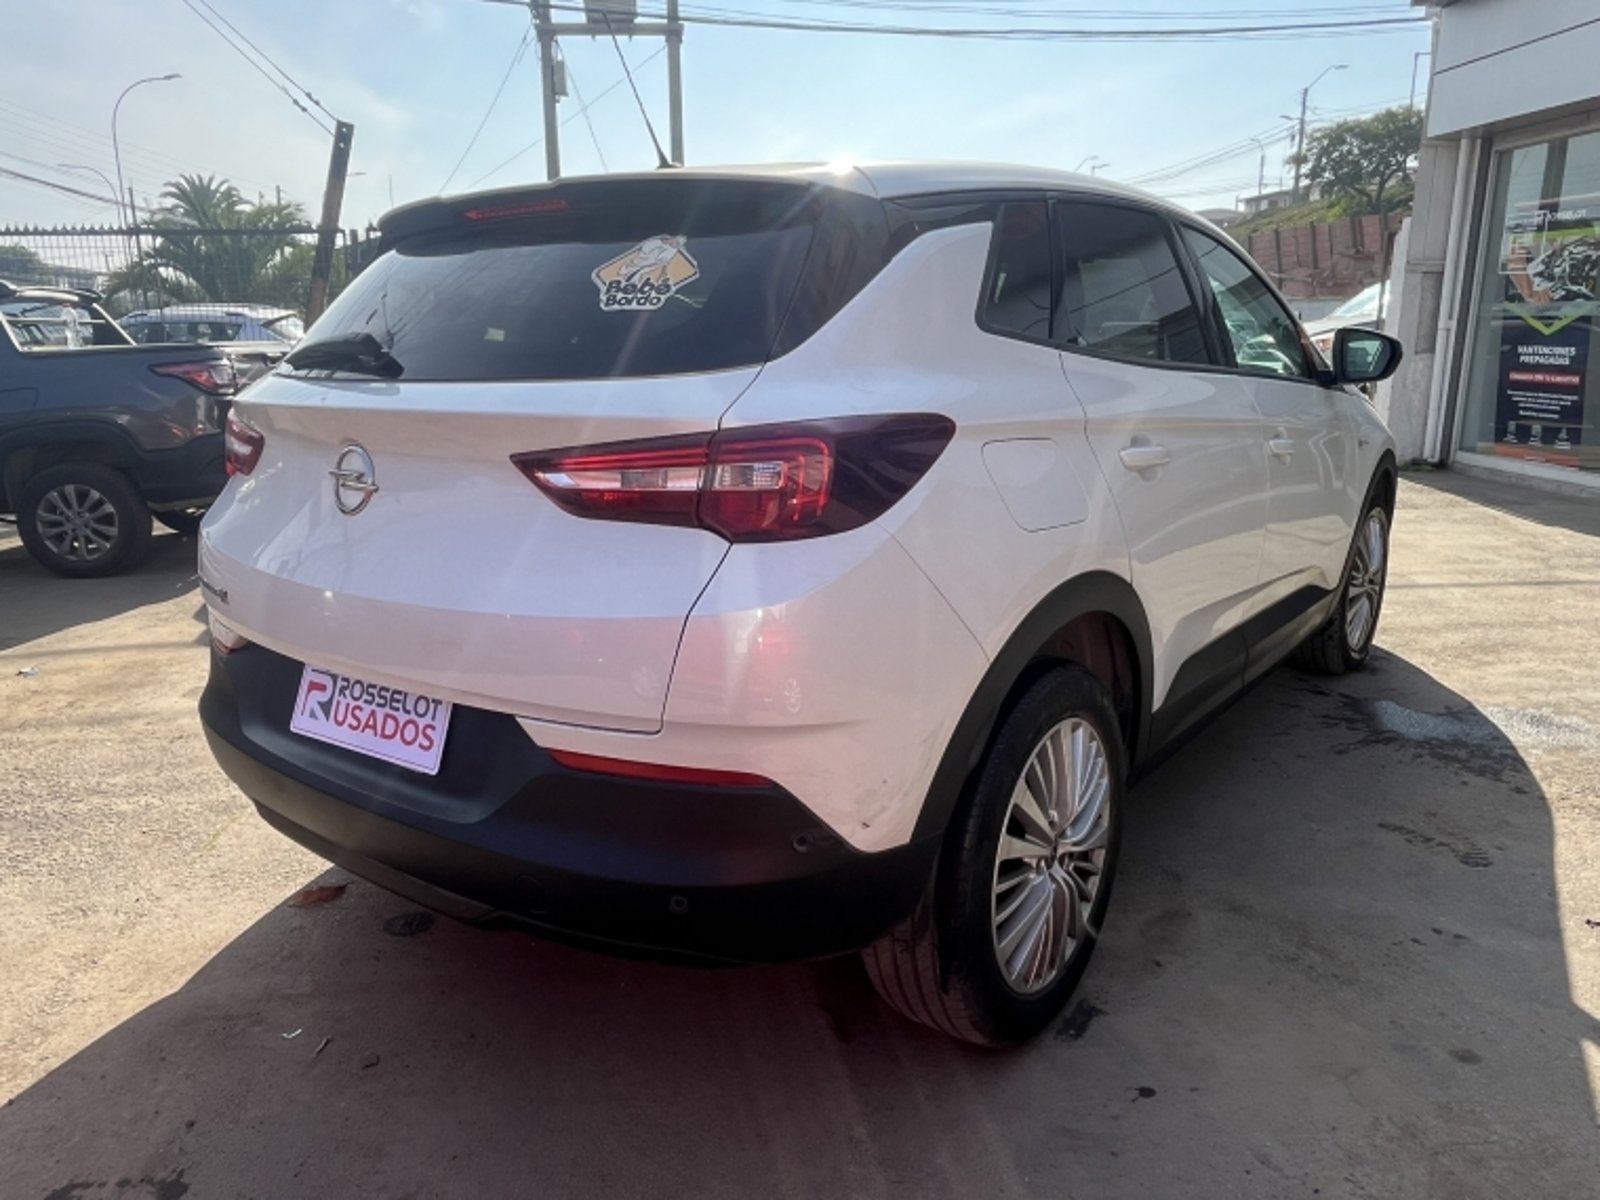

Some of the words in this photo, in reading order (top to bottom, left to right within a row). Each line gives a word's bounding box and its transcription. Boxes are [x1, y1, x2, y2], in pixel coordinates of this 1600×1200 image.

[605, 295, 662, 307] Bordo
[338, 677, 443, 721] ROSSELOT
[333, 701, 436, 752] USADOS
